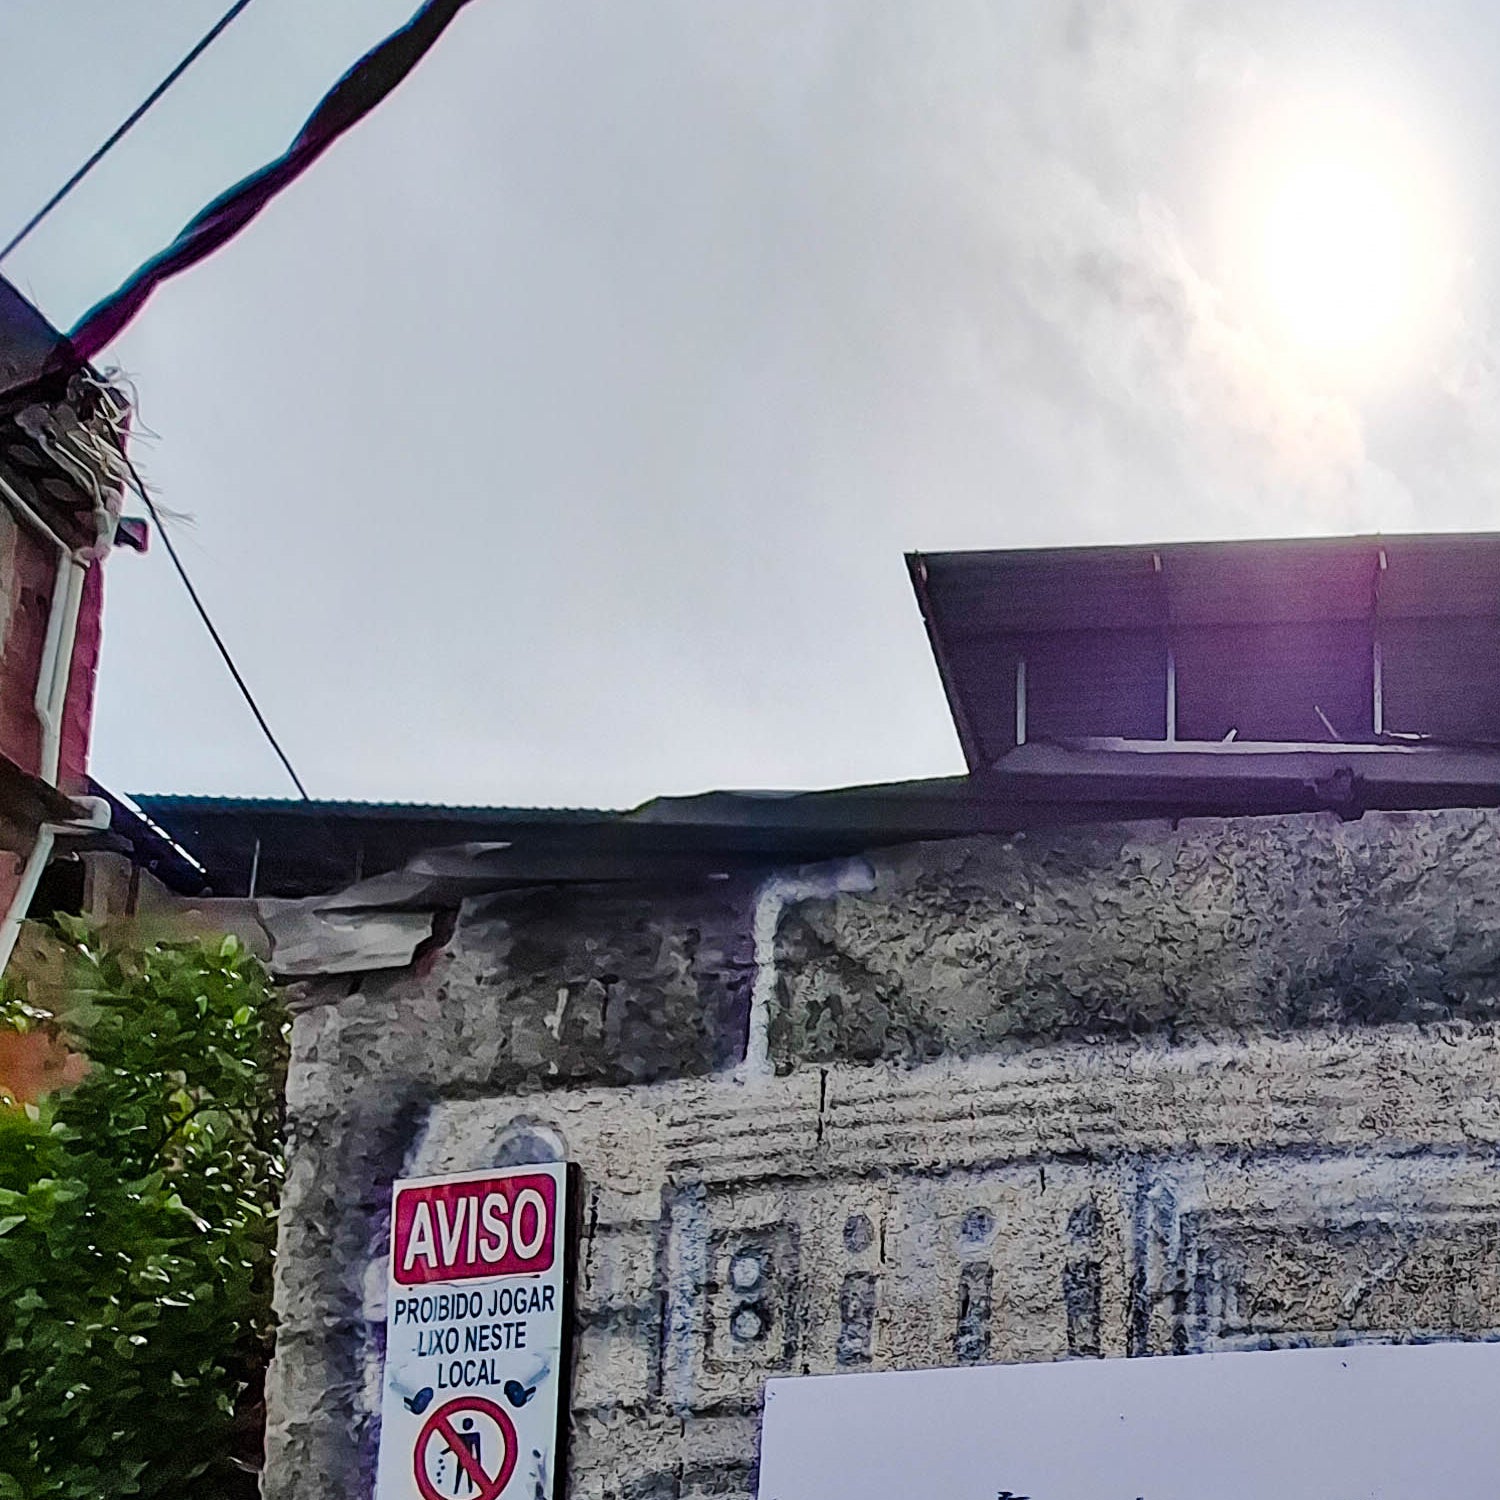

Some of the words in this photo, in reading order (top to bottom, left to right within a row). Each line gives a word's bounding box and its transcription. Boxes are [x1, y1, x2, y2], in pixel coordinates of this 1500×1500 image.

[403, 1188, 547, 1270] AVISO
[394, 1292, 483, 1325] PROIBIDO
[488, 1285, 555, 1317] JOGAR
[418, 1327, 459, 1356] LIXO
[465, 1321, 526, 1353] NESTE
[438, 1359, 501, 1388] LOCAL
